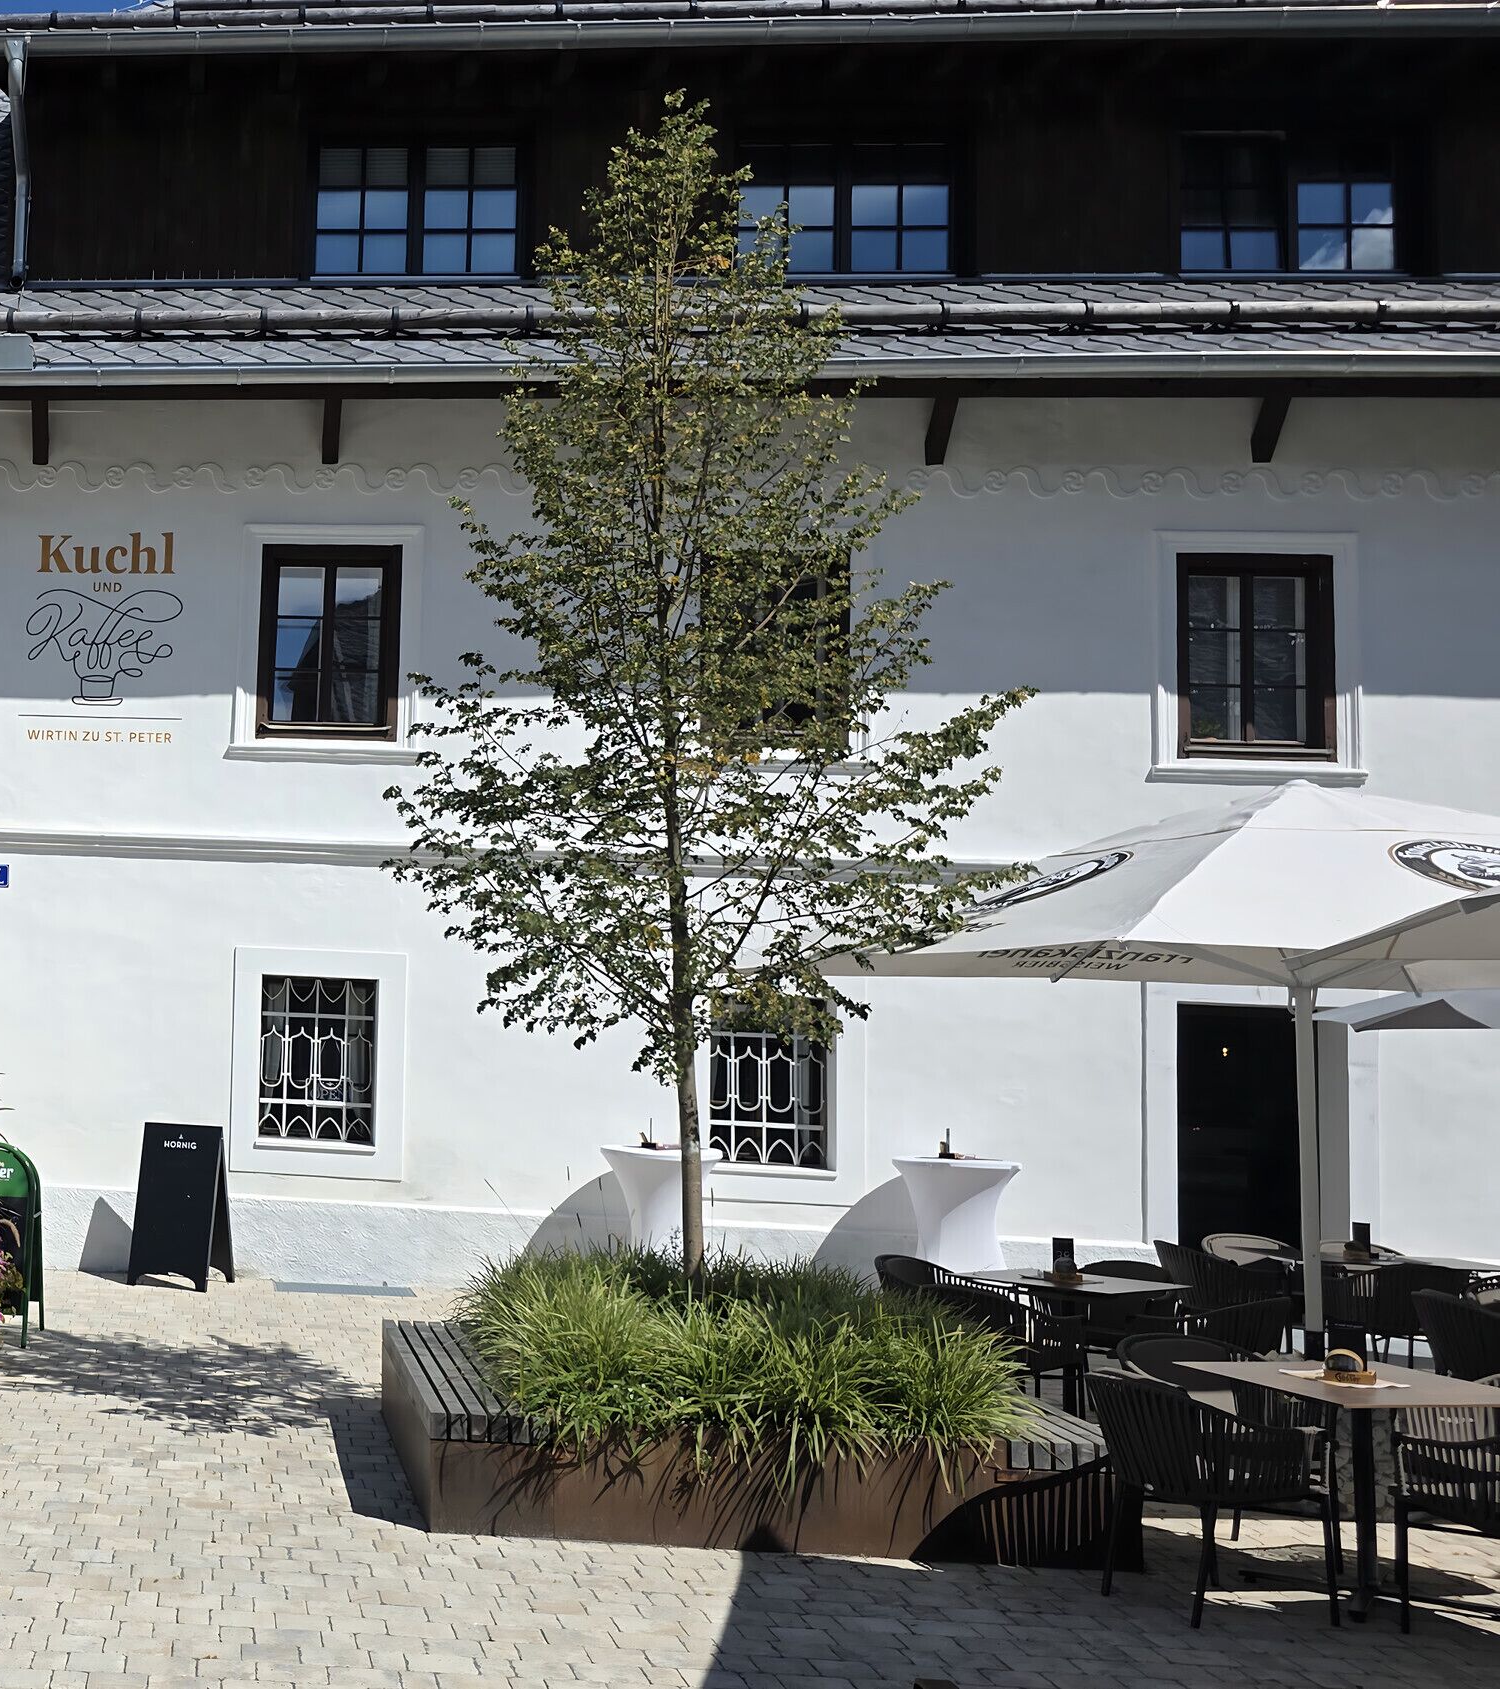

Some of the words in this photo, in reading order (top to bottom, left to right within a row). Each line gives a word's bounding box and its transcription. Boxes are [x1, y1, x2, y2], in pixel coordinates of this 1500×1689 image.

[37, 532, 176, 575] Kuchl
[93, 582, 122, 593] UND
[26, 588, 184, 670] Kaffee
[27, 729, 78, 741] WIRTIN
[82, 730, 100, 742] ZU
[104, 731, 124, 743] ST.
[129, 732, 173, 744] PETER
[163, 1140, 197, 1149] HORNIG
